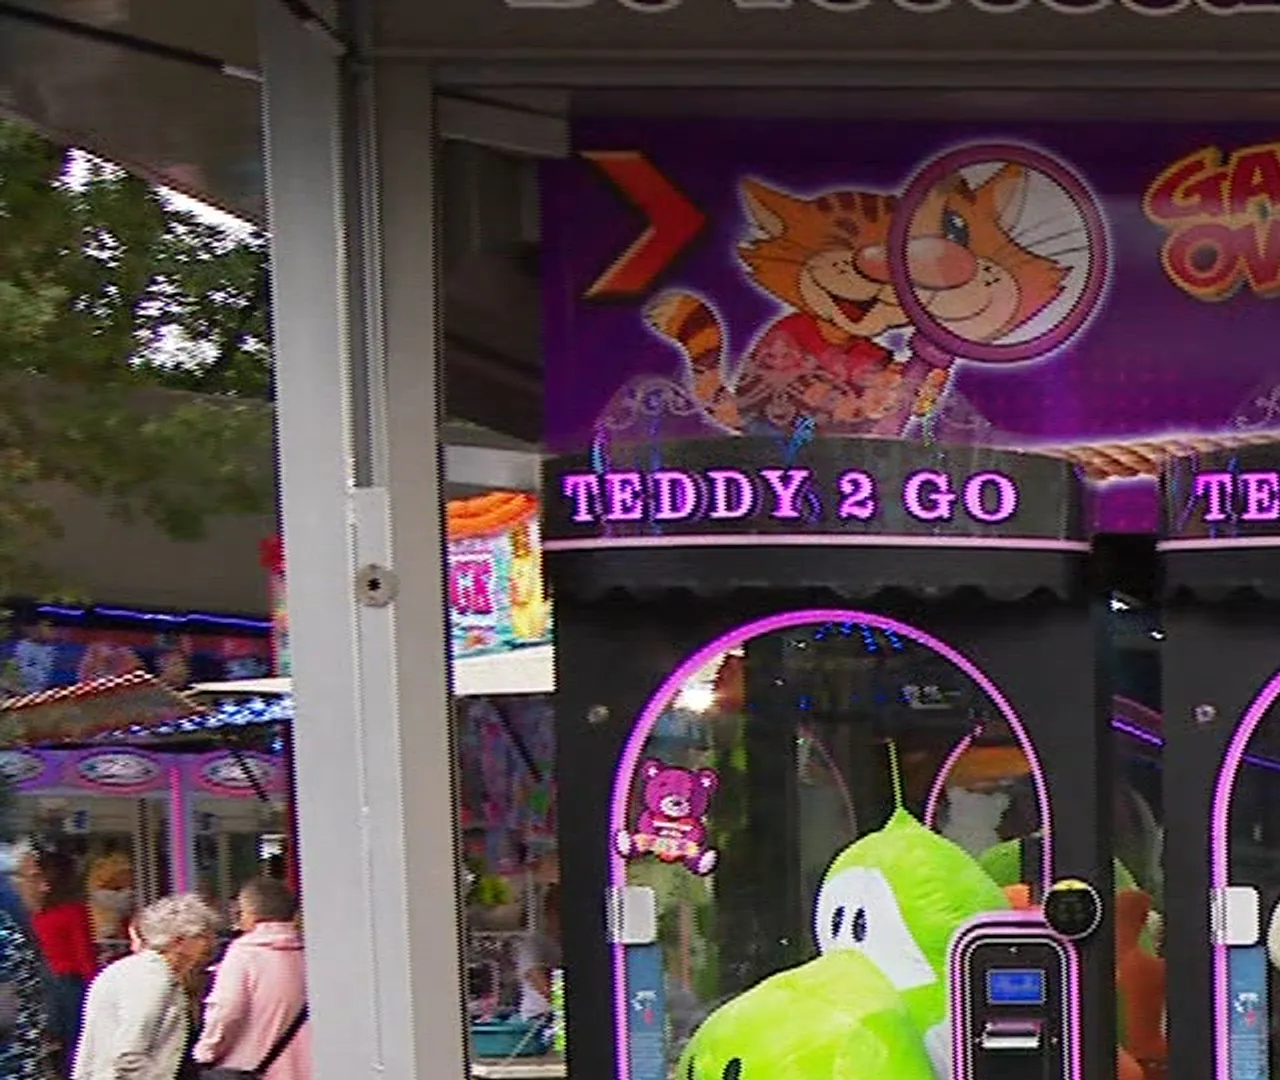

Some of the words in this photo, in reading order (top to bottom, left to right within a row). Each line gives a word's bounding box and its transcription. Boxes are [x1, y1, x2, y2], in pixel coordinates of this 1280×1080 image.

[564, 470, 808, 521] TEDDY
[838, 471, 876, 519] 2
[903, 472, 1018, 521] GO
